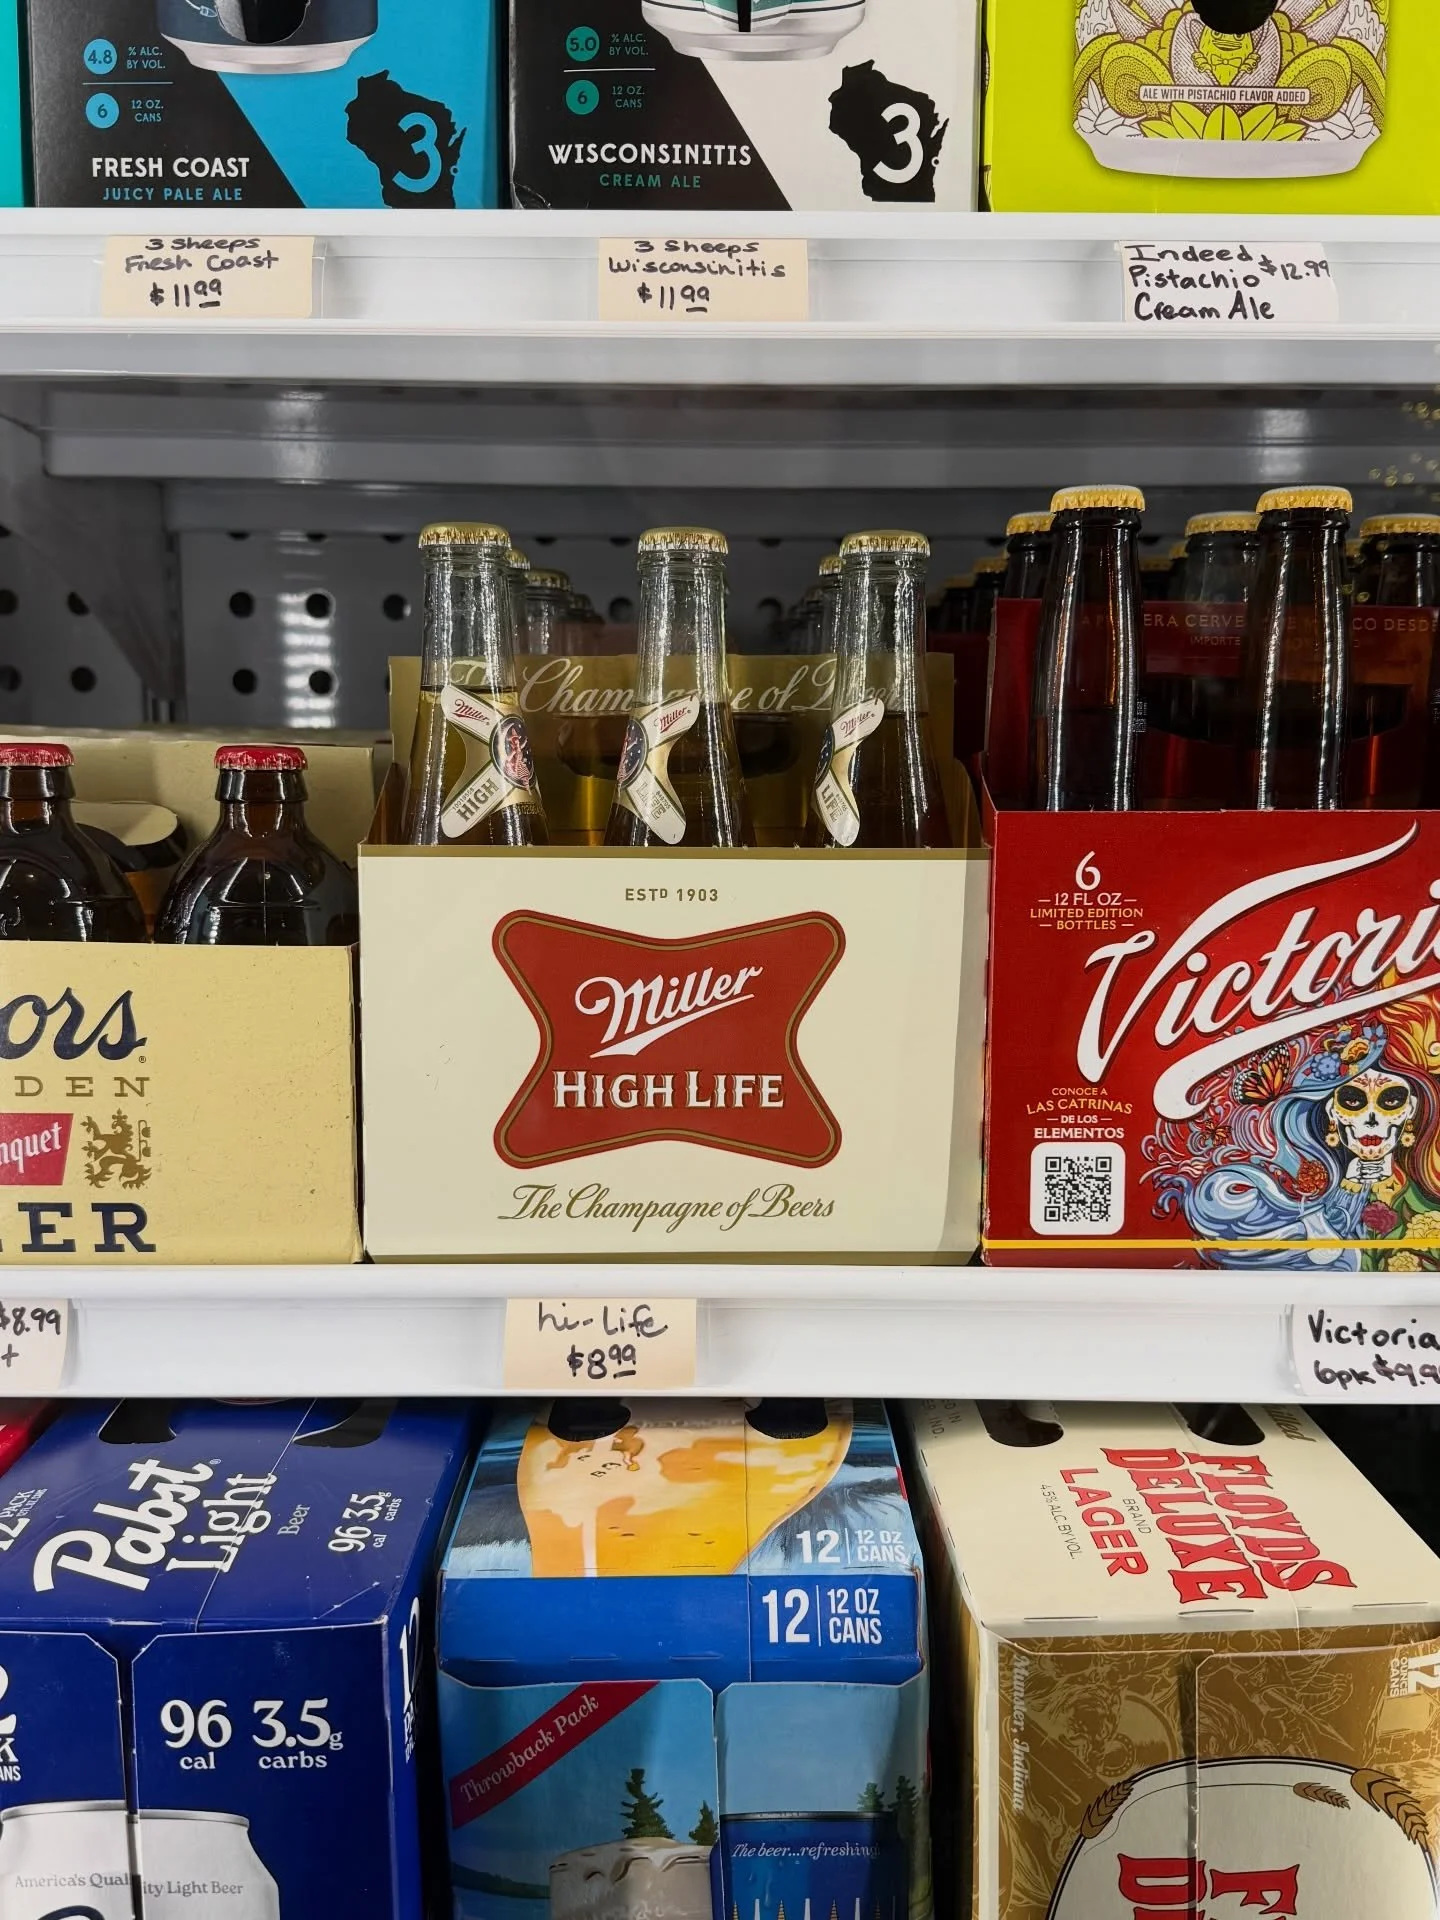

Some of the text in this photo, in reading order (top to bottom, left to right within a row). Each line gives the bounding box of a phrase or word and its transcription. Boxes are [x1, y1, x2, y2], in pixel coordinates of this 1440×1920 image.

[569, 36, 597, 53] 5.0
[611, 33, 647, 44] % ALC.
[87, 48, 113, 65] 4.8
[127, 46, 164, 57] % ALC.
[609, 45, 649, 57] BY VOL.
[127, 59, 166, 70] BY VOL.
[577, 90, 588, 105] 6
[612, 85, 645, 96] 12 OZ.
[1142, 88, 1307, 103] ALE WITH PISTACHIO FLAVOR ADDED
[97, 103, 108, 119] 6
[131, 99, 164, 110] 12 OZ.
[615, 98, 643, 110] CANS
[134, 111, 163, 123] CANS
[392, 112, 443, 193] 3
[548, 143, 752, 166] WISCONSINITIS
[872, 102, 925, 184] 3
[92, 157, 250, 178] FRESH COAST
[600, 173, 702, 189] CREAM ALE
[103, 187, 243, 201] JUICY PALE ALE
[145, 238, 164, 250] 3
[634, 241, 655, 253] 3
[125, 250, 279, 273] Fresh Coast
[608, 257, 787, 278] Wisconsinitis
[1124, 244, 1331, 282] Indeed $12.99
[1129, 265, 1261, 289] Pistachio
[1134, 290, 1275, 321] Cream Ale
[453, 699, 490, 723] Miller
[654, 706, 687, 733] Miller
[456, 778, 499, 822] HIGH
[1075, 850, 1101, 891] 6
[676, 888, 719, 902] 1903
[1055, 893, 1122, 906] 12 FL OZ
[1030, 908, 1143, 919] LIMITED EDITION
[1057, 919, 1117, 930] BOTTLES
[1077, 819, 1440, 1082] Victori
[575, 966, 763, 1058] Miller
[552, 1070, 785, 1109] HIGH LIFE
[1051, 1087, 1109, 1097] CONOCE A
[1026, 1098, 1133, 1115] LAS CATRINAS
[1061, 1115, 1098, 1124] DE LOS
[1034, 1127, 1124, 1139] ELEMENTOS
[497, 1182, 836, 1234] The Champagne of Beers
[0, 1202, 156, 1252] ER
[1307, 1309, 1440, 1351] Victoria
[1313, 1353, 1440, 1390] 6pk $9.9
[33, 1458, 214, 1592] Pabst
[166, 1472, 278, 1573] Light
[277, 1504, 311, 1536] Beer
[373, 1498, 402, 1548] cal carbs
[1048, 1503, 1067, 1524] ALC.
[1059, 1468, 1149, 1577] LAGER
[1122, 1498, 1152, 1534] BRAND
[1183, 1450, 1358, 1591] FLOYDS
[1058, 1524, 1075, 1537] BY
[1100, 1447, 1269, 1605] DELUXE
[328, 1526, 372, 1552] 96
[796, 1529, 908, 1564] 12 12 OZ CANS
[1064, 1537, 1082, 1560] VOL.
[762, 1589, 882, 1645] 12 12 OZ CANS
[1390, 1658, 1400, 1697] CANS
[1400, 1656, 1408, 1696] OUNCE
[160, 1699, 232, 1749] 96
[460, 1727, 556, 1803] Throwback
[552, 1694, 600, 1740] Pack
[180, 1751, 327, 1770] cal carbs
[1011, 1739, 1031, 1810] Indiana
[732, 1843, 756, 1857] The
[15, 1873, 87, 1888] America's
[167, 1880, 209, 1896] Light
[212, 1881, 244, 1895] Beer
